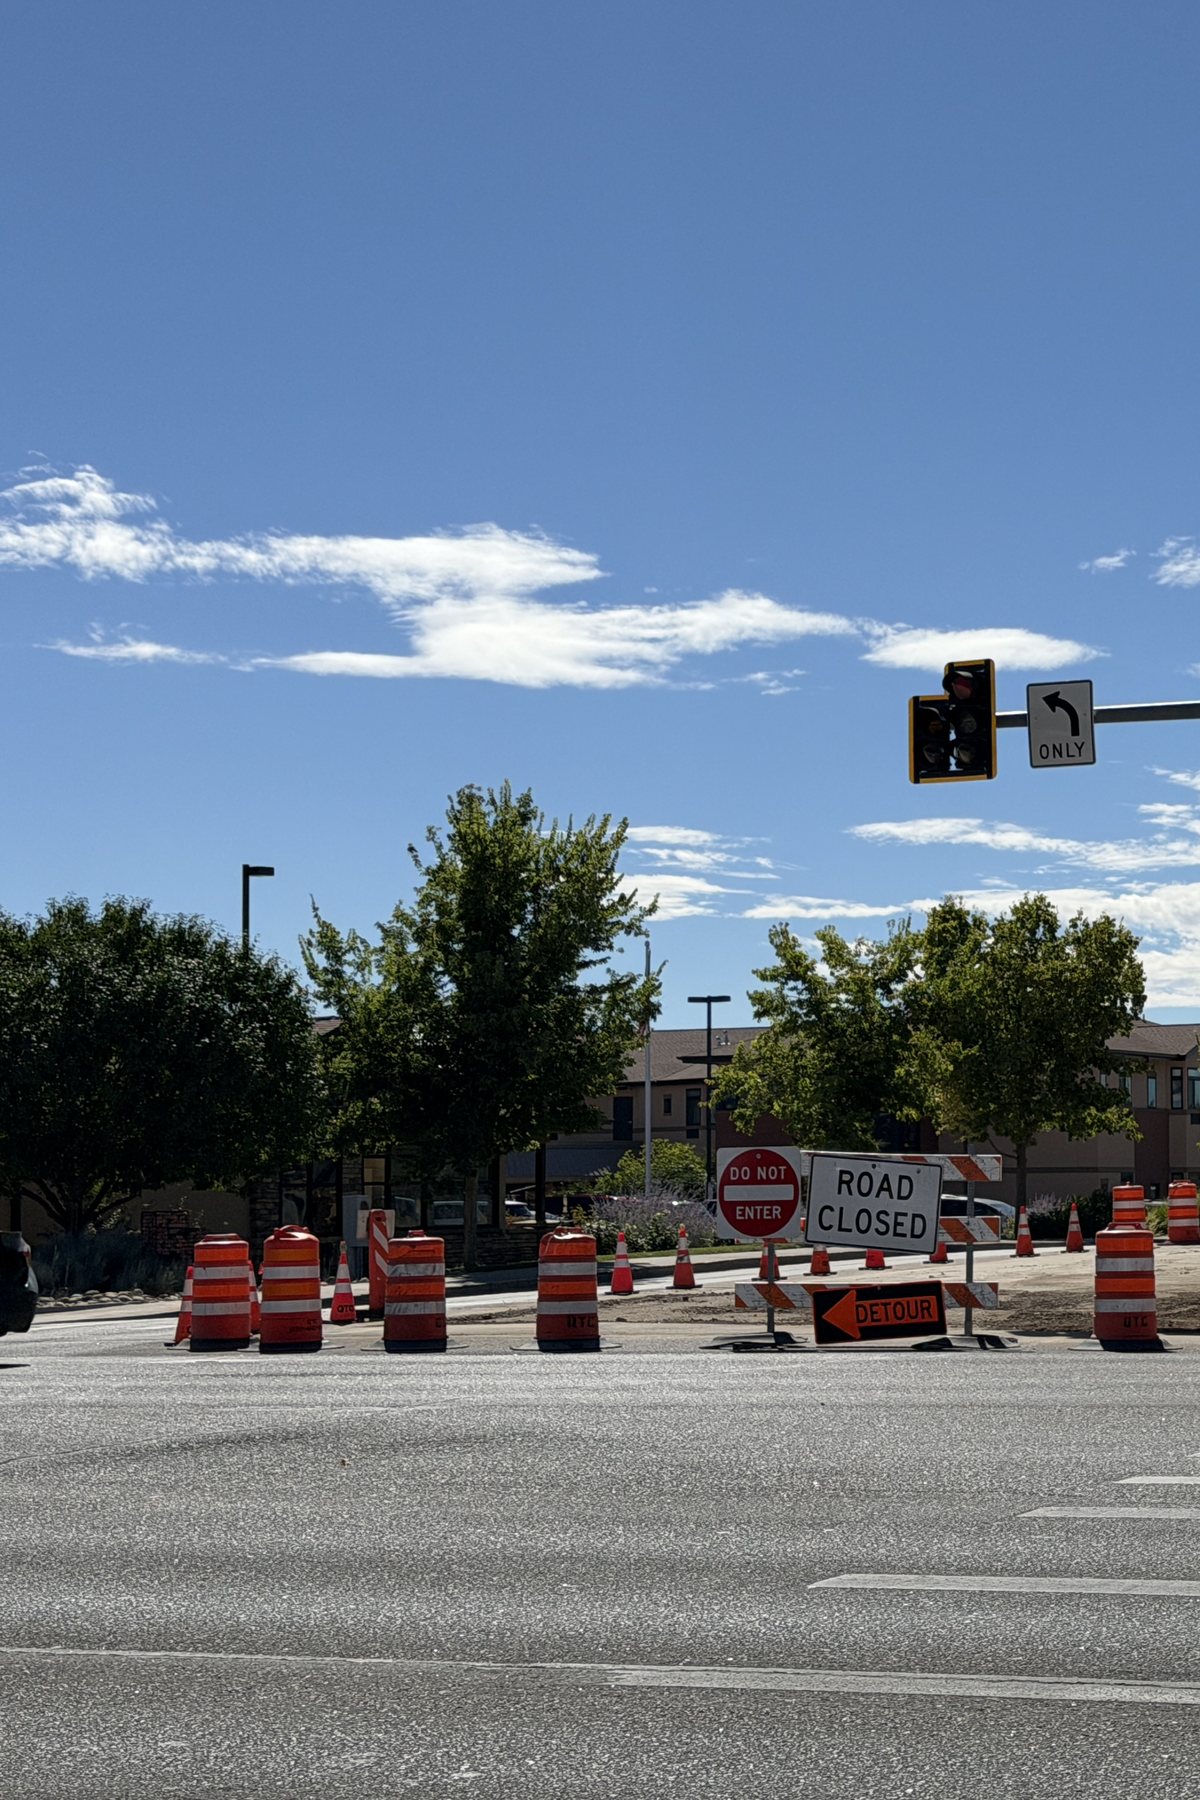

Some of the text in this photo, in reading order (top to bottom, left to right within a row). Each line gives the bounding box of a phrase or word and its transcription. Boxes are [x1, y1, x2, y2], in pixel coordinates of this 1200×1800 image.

[1039, 741, 1085, 760] ONLY
[730, 1166, 787, 1181] DO NOT
[837, 1169, 914, 1201] ROAD
[736, 1206, 782, 1220] ENTER
[817, 1204, 928, 1240] CLOSED
[855, 1299, 934, 1324] DETOUR
